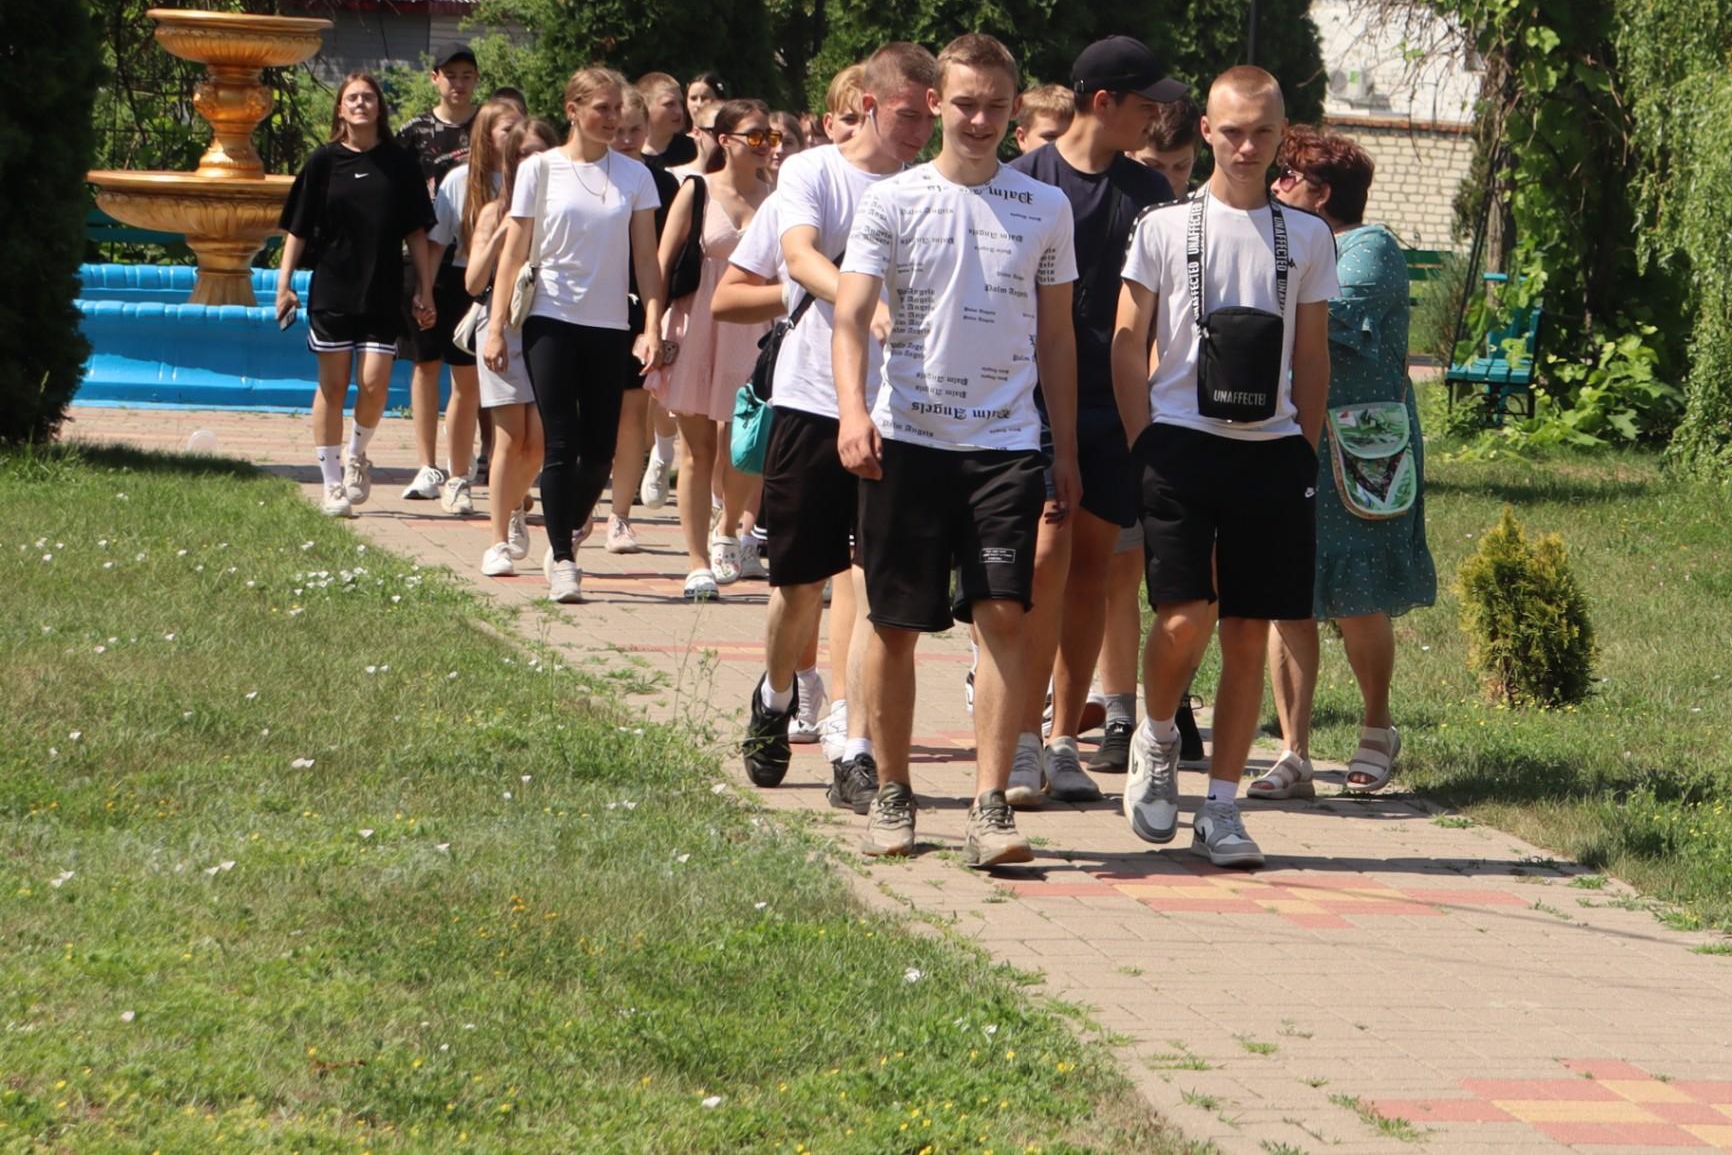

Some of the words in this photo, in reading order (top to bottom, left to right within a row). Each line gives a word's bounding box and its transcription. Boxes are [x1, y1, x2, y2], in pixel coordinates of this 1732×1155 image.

[1187, 202, 1203, 255] UNAFFECTED
[1273, 217, 1288, 271] UNAFFECTED
[911, 401, 967, 421] Angels
